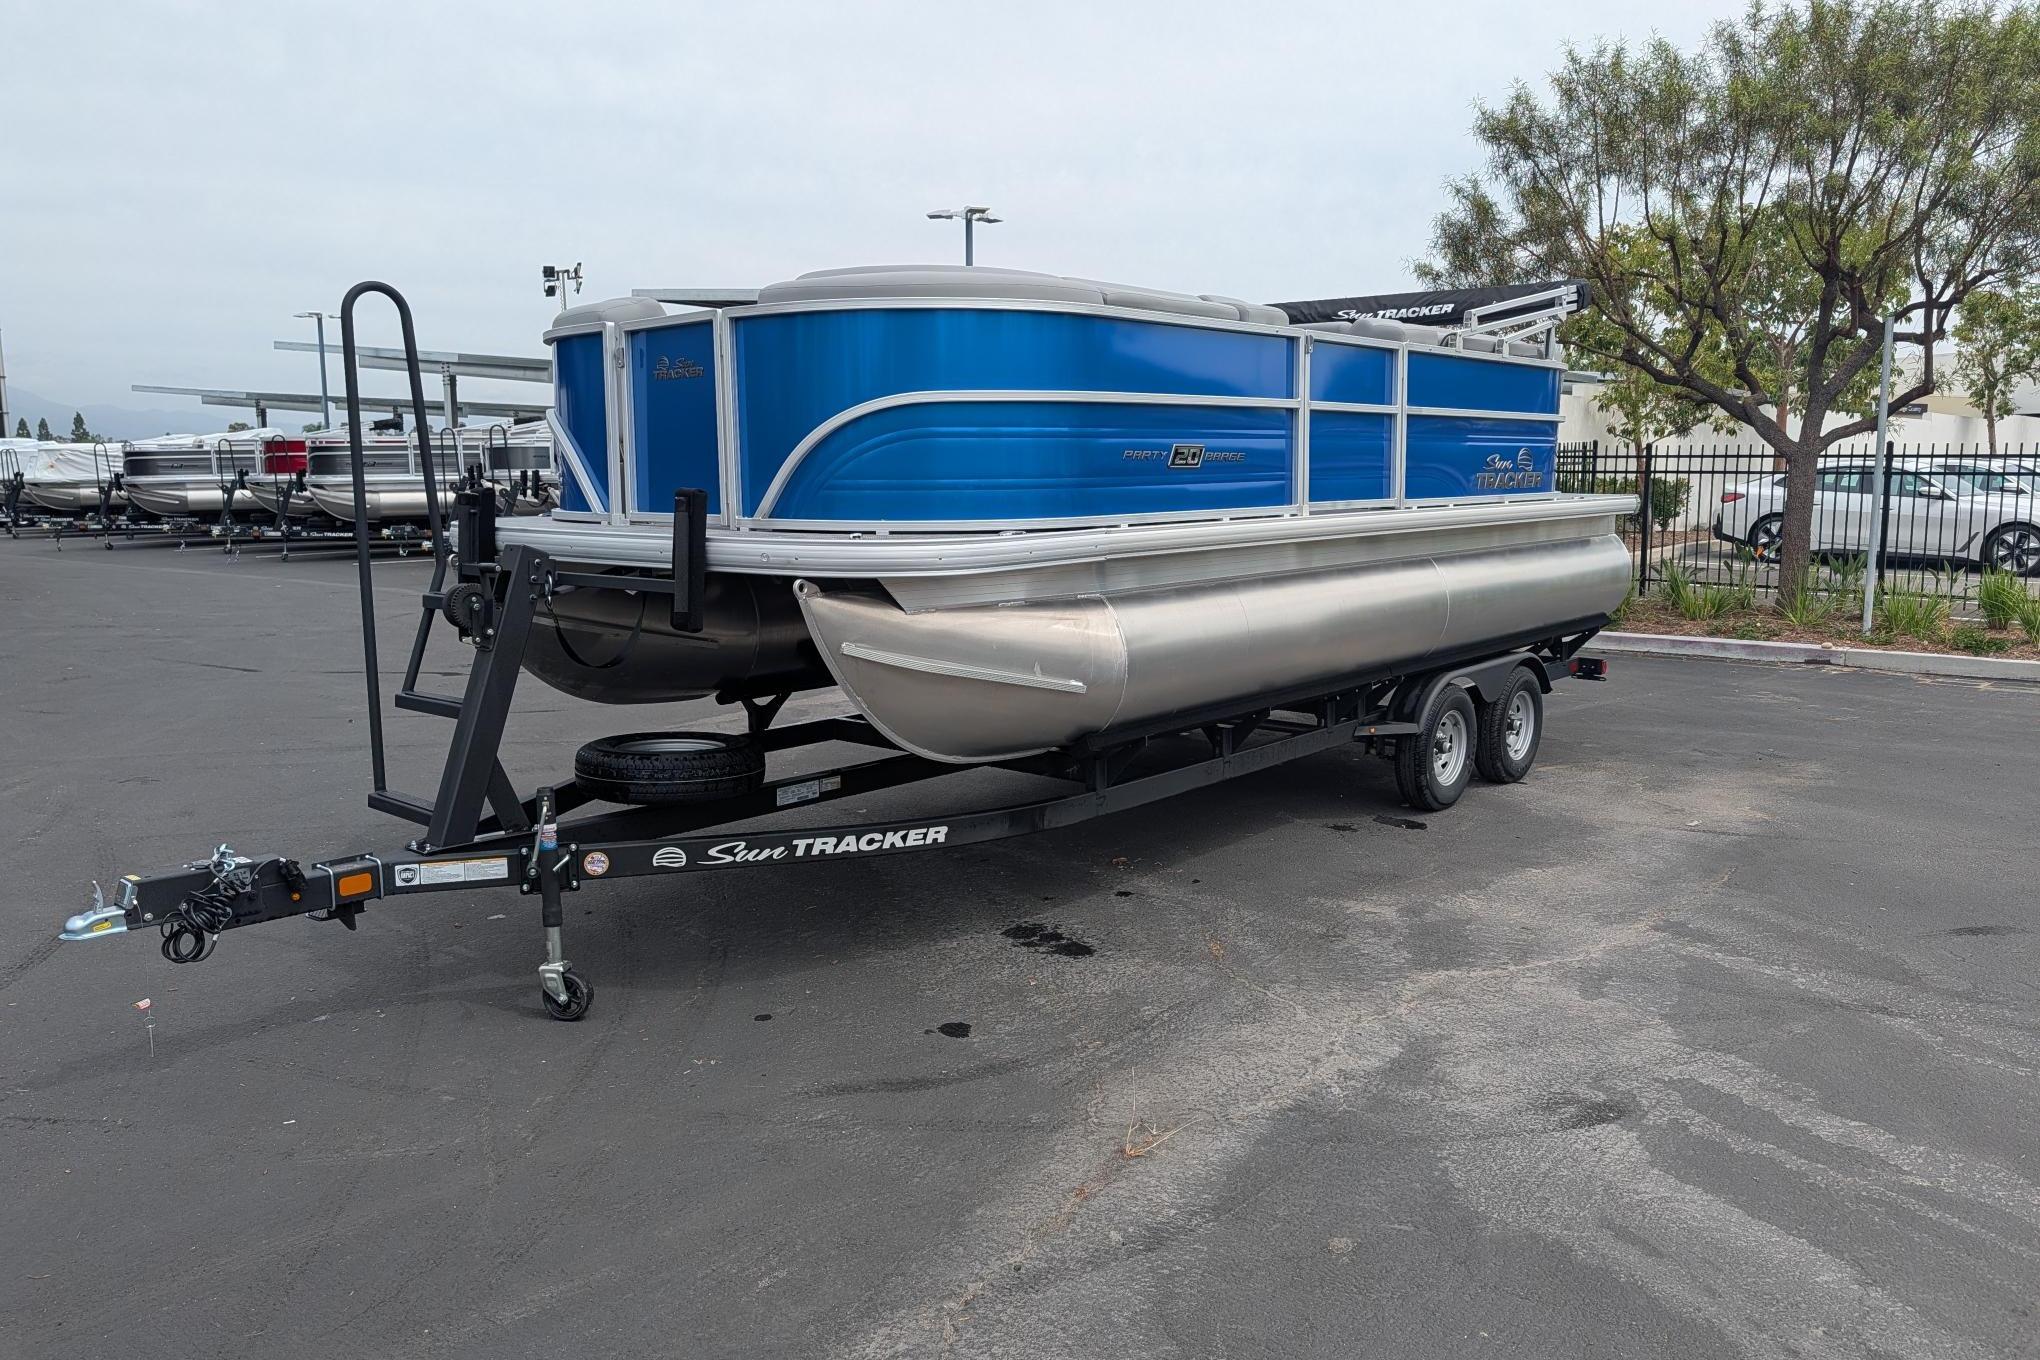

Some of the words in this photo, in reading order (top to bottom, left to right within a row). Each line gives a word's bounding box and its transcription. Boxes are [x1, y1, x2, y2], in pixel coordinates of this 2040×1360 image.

[1332, 309, 1375, 320] Sun
[1376, 303, 1455, 320] TRACKER
[653, 367, 704, 381] TRACKER
[1122, 450, 1169, 461] PARTY
[1174, 448, 1201, 465] 20
[1204, 451, 1247, 462] BARGE
[1476, 471, 1543, 490] TRACKER
[696, 841, 789, 865] Sun
[792, 825, 949, 857] TRACKER
